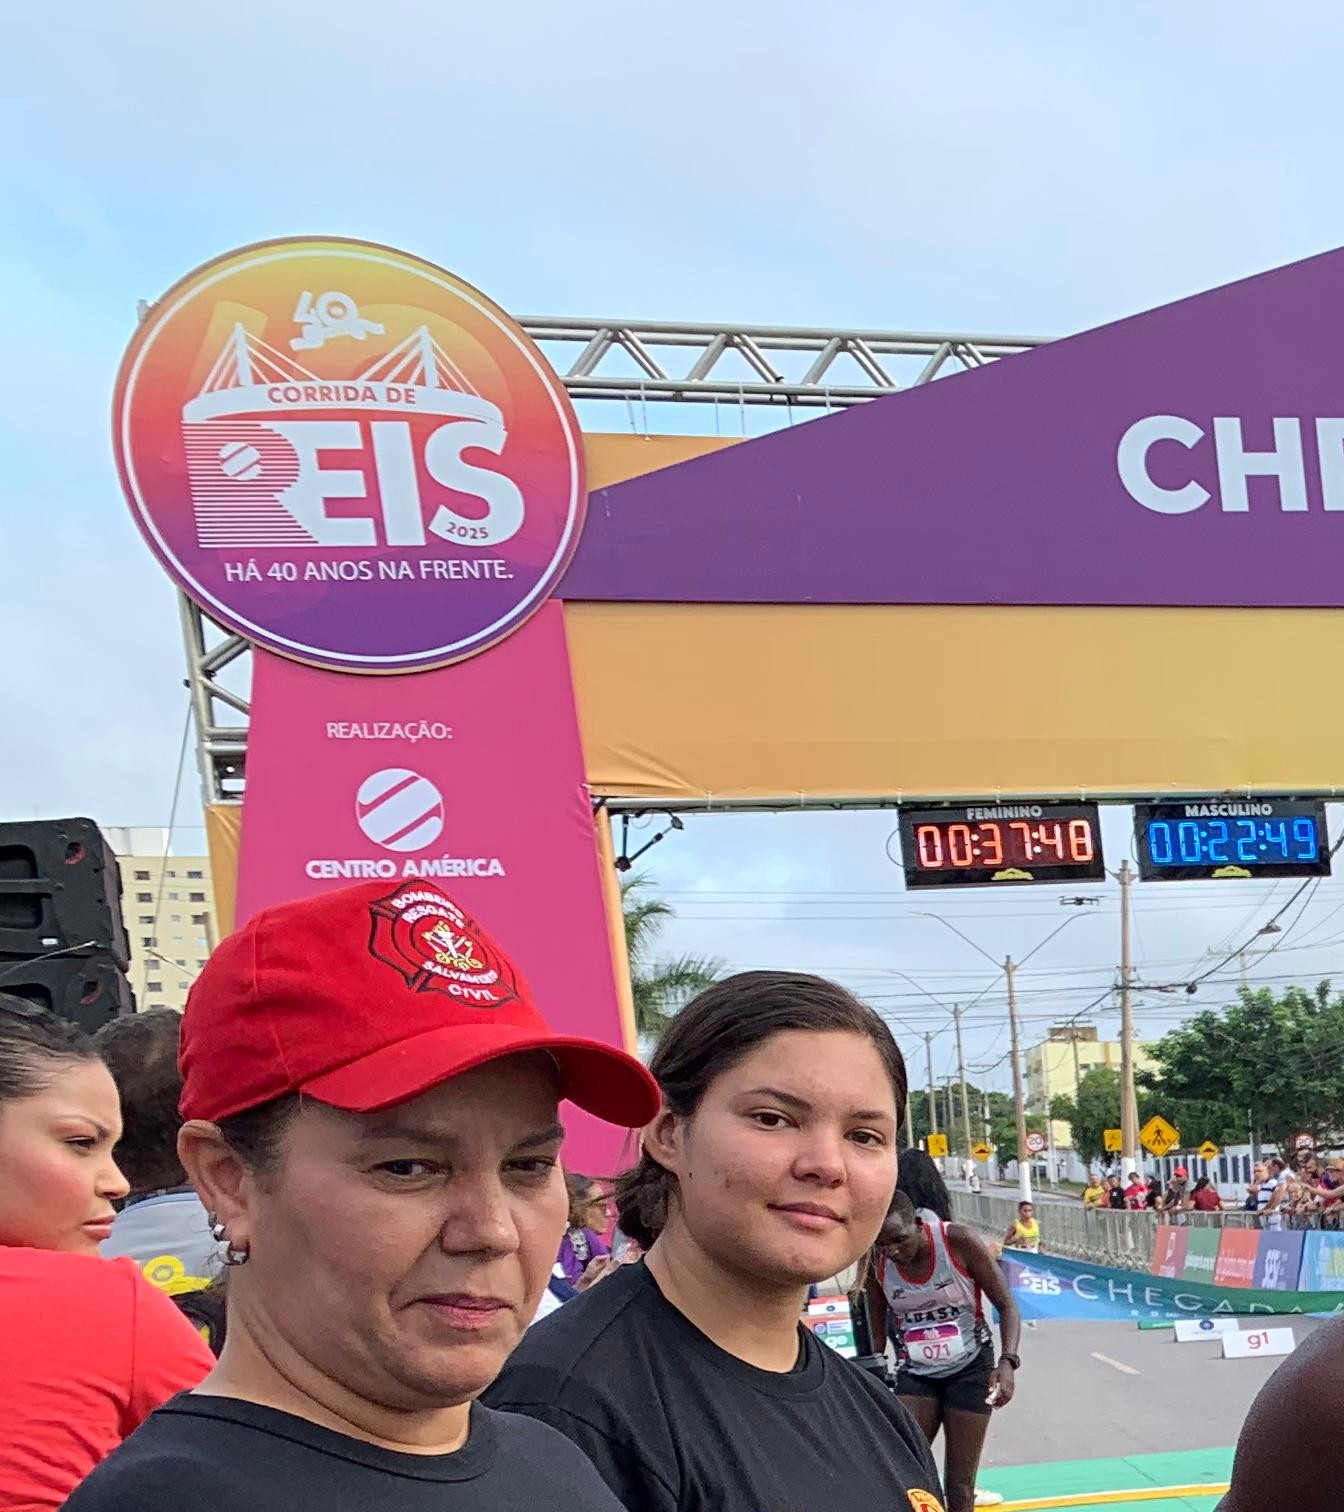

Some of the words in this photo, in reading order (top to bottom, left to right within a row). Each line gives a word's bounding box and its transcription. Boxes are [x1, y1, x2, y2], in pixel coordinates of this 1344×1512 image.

[267, 385, 378, 406] CORRIDA
[385, 386, 417, 405] DE
[180, 419, 526, 548] REIS
[445, 521, 490, 540] 2025
[223, 558, 263, 582] HÁ
[267, 561, 298, 582] 40
[303, 559, 374, 581] ANOS
[377, 559, 415, 581] NA
[419, 559, 515, 580] FRENTE.
[326, 720, 454, 744] REALIZAÇÃO:
[965, 805, 1044, 820] FEMININO
[1184, 803, 1274, 817] MASCULINO
[916, 819, 1096, 868] 00:37:48
[1148, 819, 1316, 864] 00:22:49
[305, 858, 397, 879] CENTRO
[401, 854, 506, 878] AMÉRICA
[447, 984, 500, 1001] CIVIL
[1028, 1137, 1042, 1147] 20
[1247, 1330, 1270, 1350] g1
